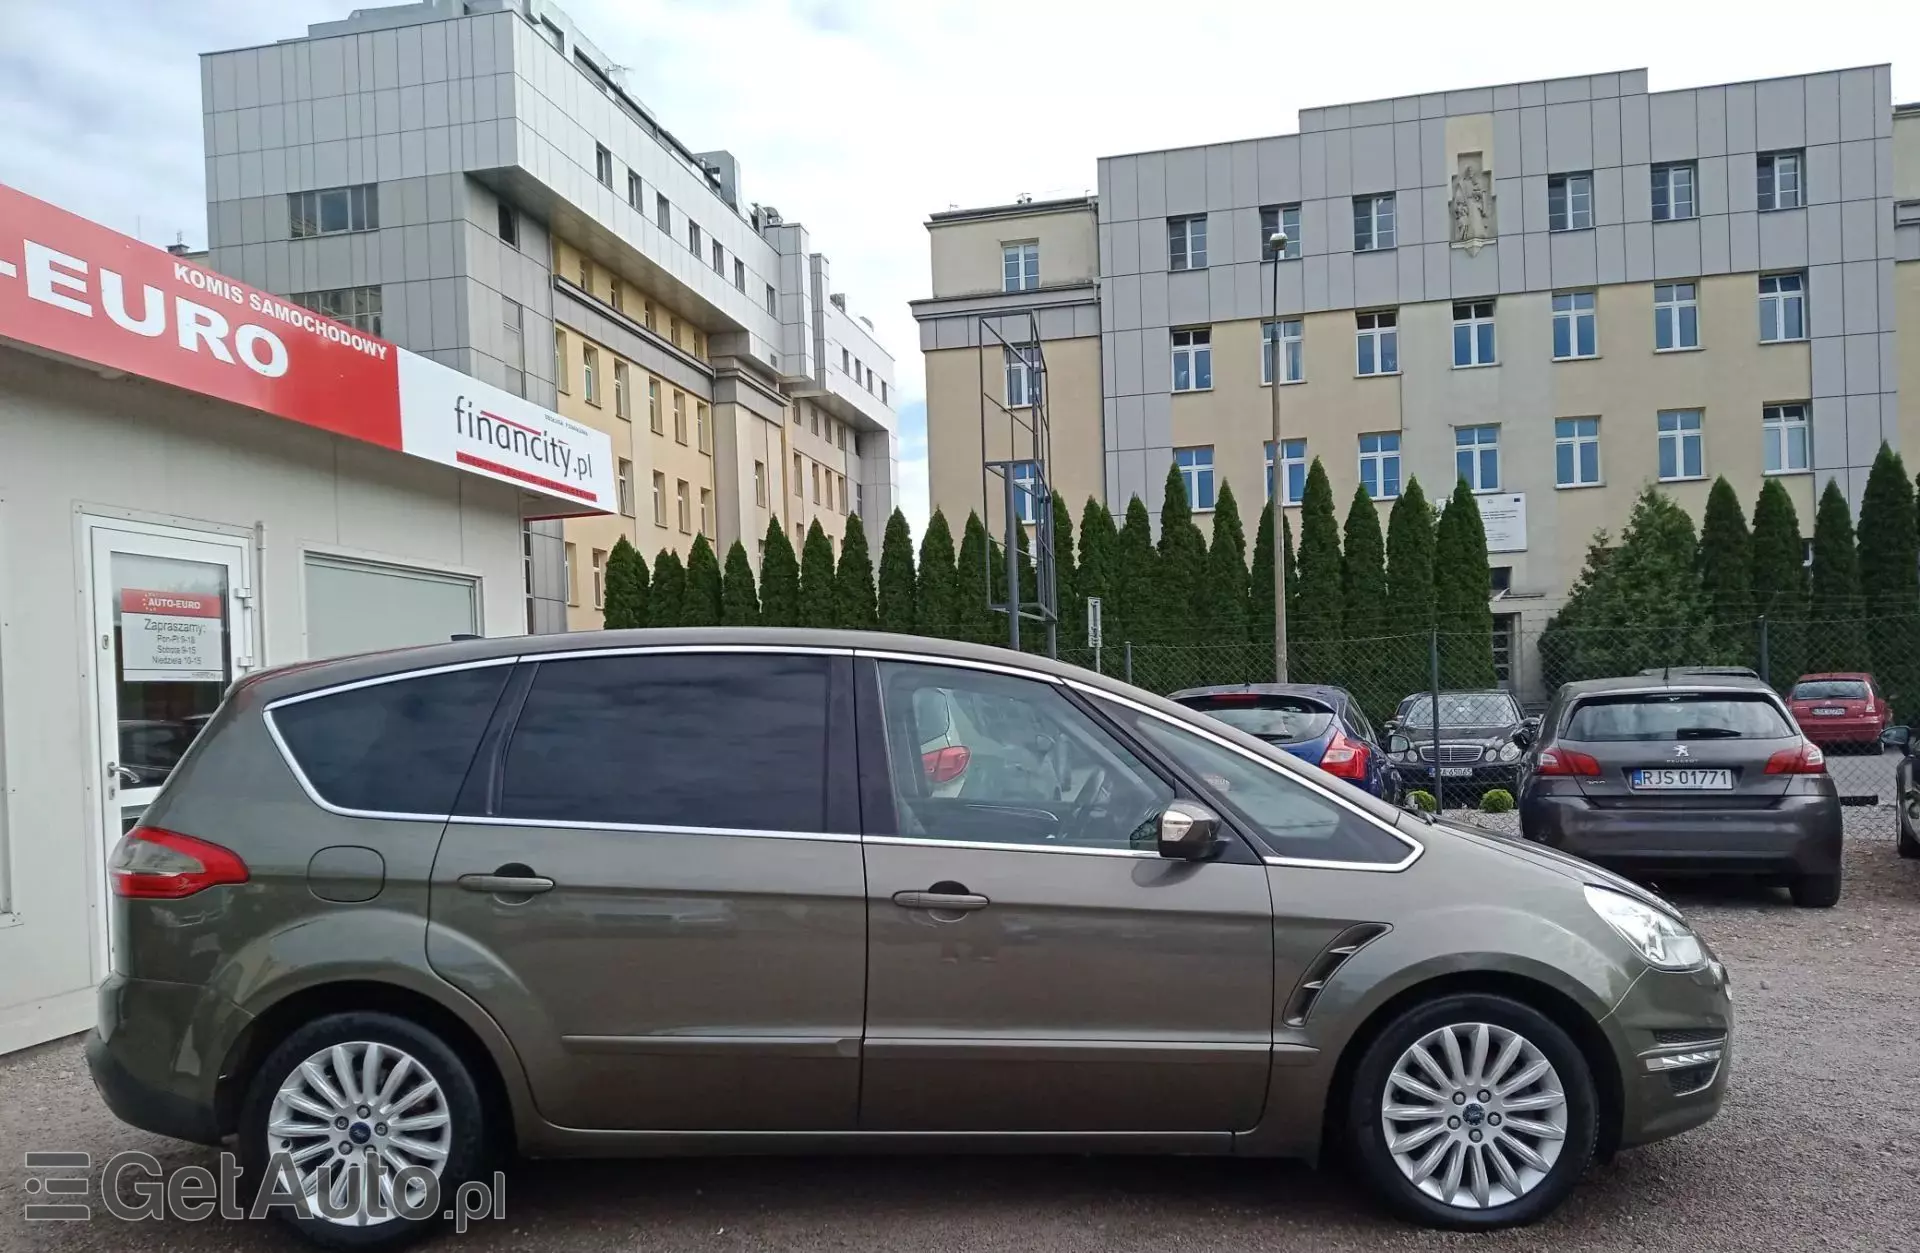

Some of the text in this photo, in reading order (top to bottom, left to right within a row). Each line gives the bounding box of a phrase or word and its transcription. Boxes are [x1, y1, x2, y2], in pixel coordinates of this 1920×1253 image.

[174, 262, 387, 360] KOMIS SAMOCHODOWY
[454, 396, 592, 481] financity.pl
[148, 599, 201, 610] AUTO-EURO
[144, 618, 207, 635] Zapraszamy:
[1642, 770, 1727, 785] RJS 01771
